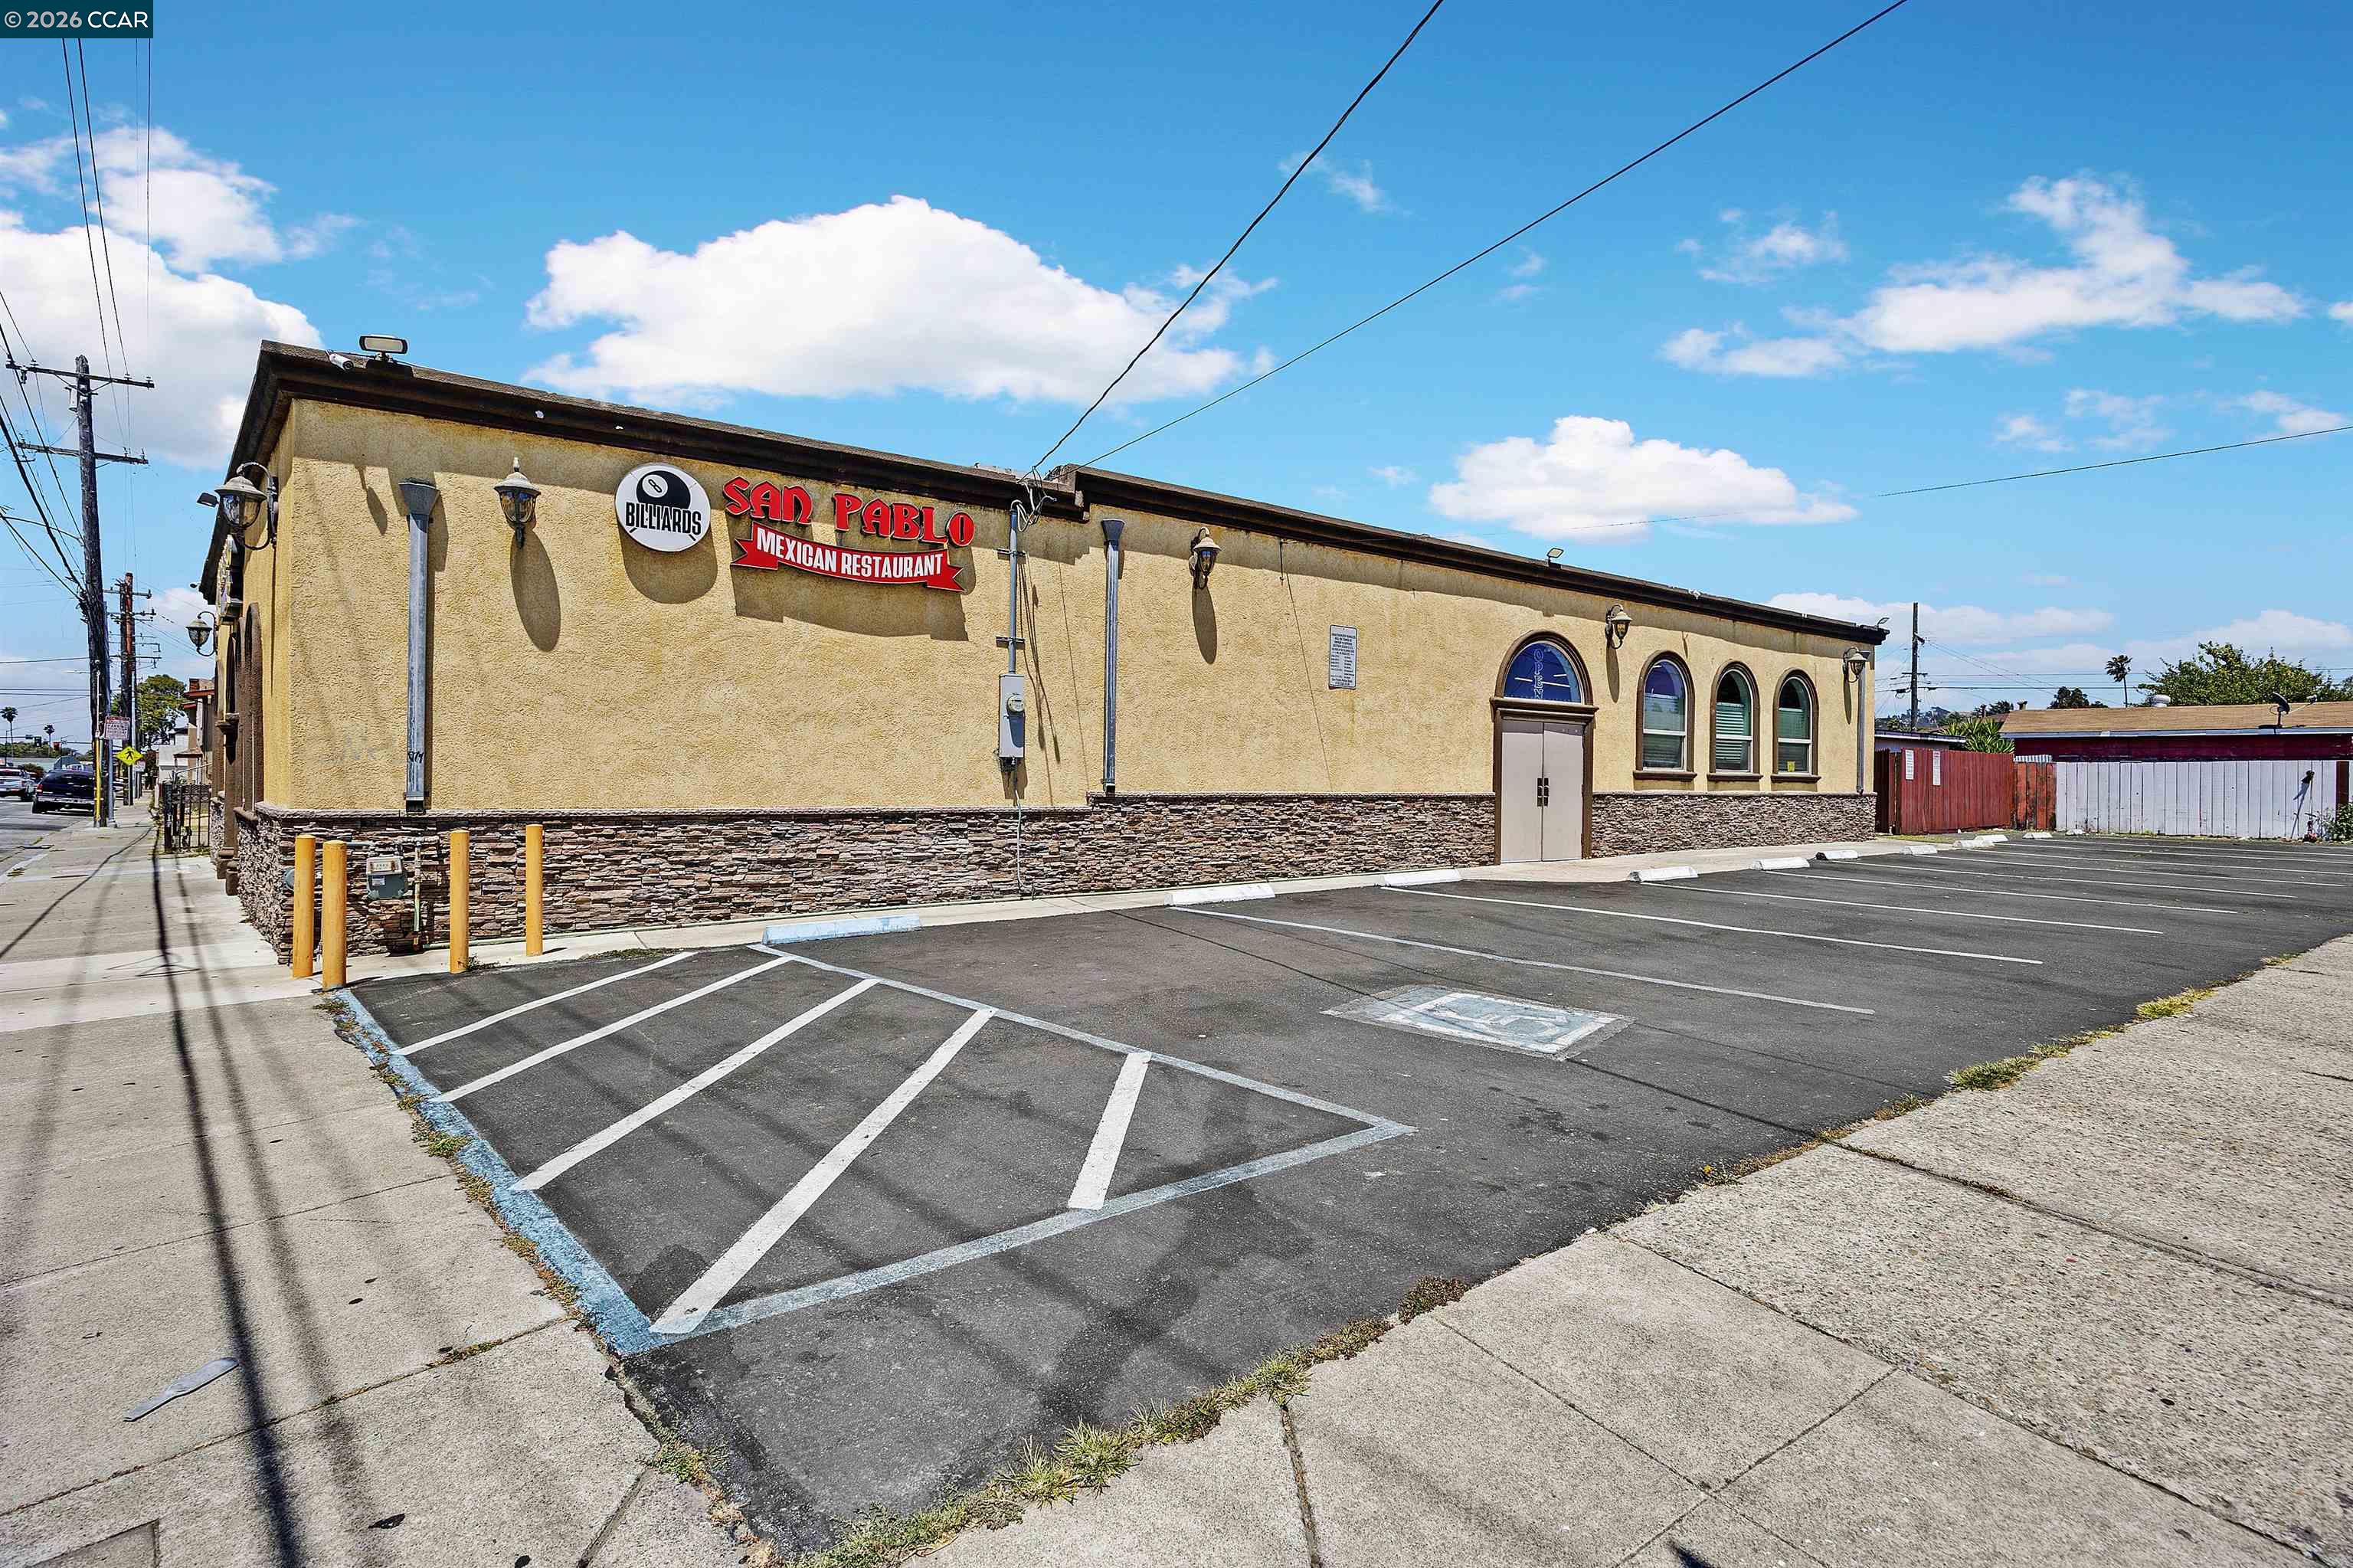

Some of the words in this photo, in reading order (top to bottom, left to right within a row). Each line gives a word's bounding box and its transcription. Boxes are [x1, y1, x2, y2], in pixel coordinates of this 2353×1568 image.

[648, 479, 663, 493] 8
[723, 476, 813, 525] SAN
[833, 492, 975, 547] PABLO
[625, 502, 702, 535] BILLIARDS
[757, 527, 837, 573] MEXICAN
[841, 552, 944, 578] RESTAURANT
[1533, 648, 1544, 699] OPEN
